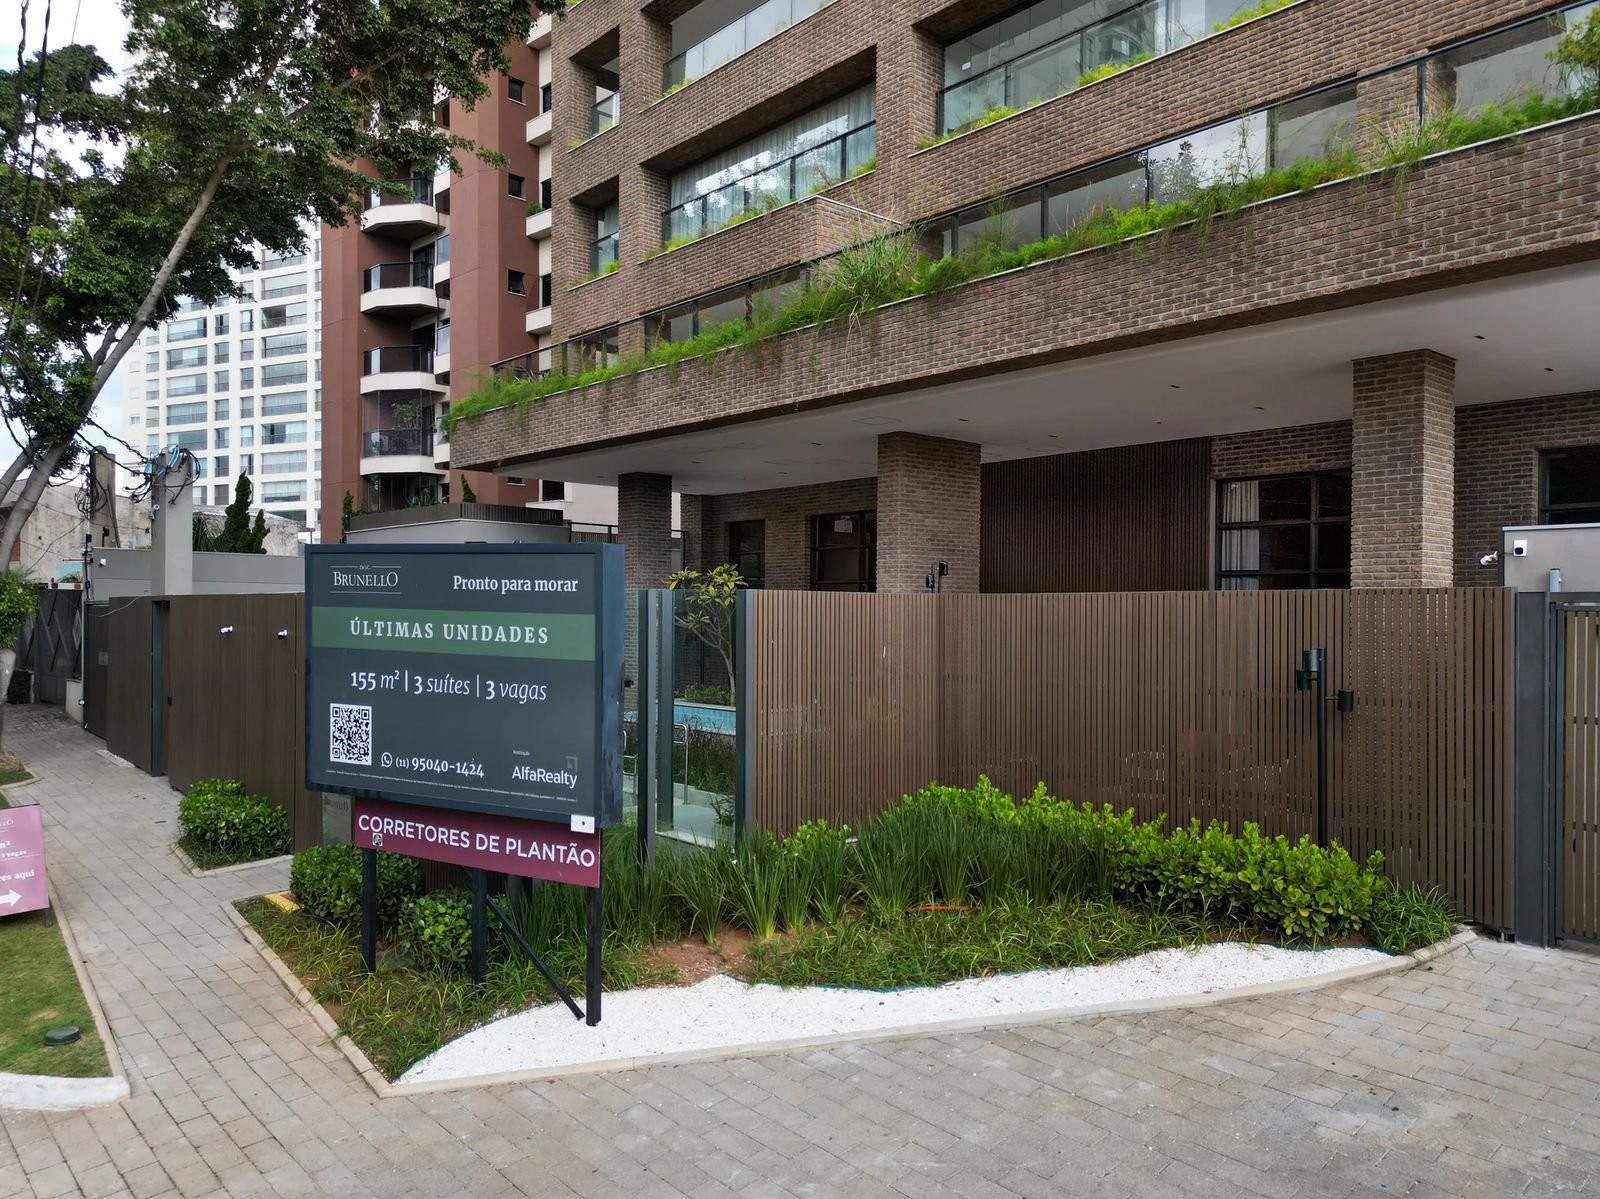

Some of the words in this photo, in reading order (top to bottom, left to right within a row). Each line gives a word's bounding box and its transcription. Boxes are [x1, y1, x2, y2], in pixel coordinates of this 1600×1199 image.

[333, 571, 399, 587] BRUNELLO
[453, 575, 498, 591] Pronto
[501, 579, 532, 595] para
[534, 579, 579, 592] morar
[350, 616, 434, 639] ÚLTIMAS
[443, 623, 548, 644] UNIDADES
[350, 671, 376, 691] 155
[414, 676, 423, 694] 3
[426, 673, 471, 695] suítes
[485, 680, 496, 700] 3
[499, 682, 547, 704] vagas
[395, 757, 410, 769] (11)
[411, 757, 485, 778] 95040-1424
[511, 765, 578, 789] AlfaRealty
[359, 814, 470, 849] CORRETORES
[475, 833, 500, 853] DE
[505, 837, 595, 868] PLANTÃO
[14, 869, 35, 880] aqui
